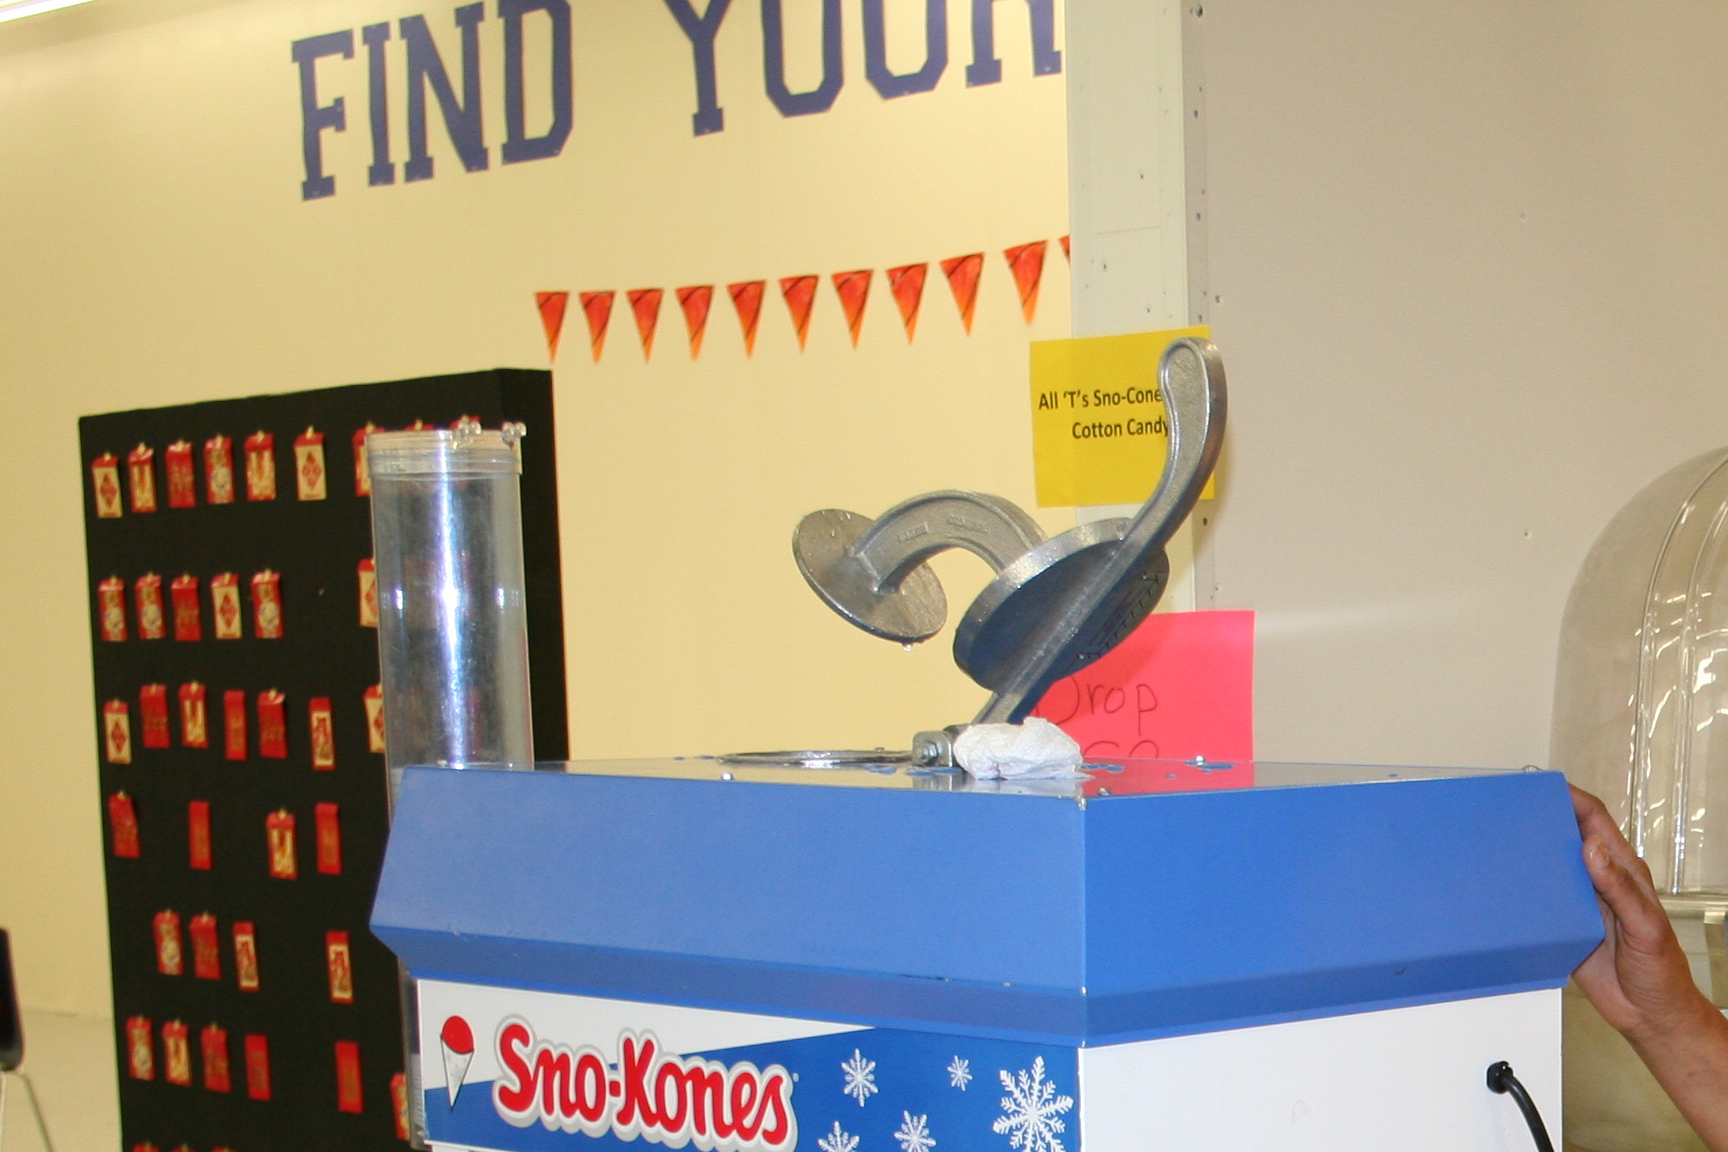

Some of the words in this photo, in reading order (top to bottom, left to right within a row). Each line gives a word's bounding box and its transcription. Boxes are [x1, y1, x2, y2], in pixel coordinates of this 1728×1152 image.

[291, 0, 573, 200] FIND
[1039, 392, 1058, 410] All
[1072, 422, 1122, 439] Cotton
[497, 1019, 793, 1150] Sno-Kones
